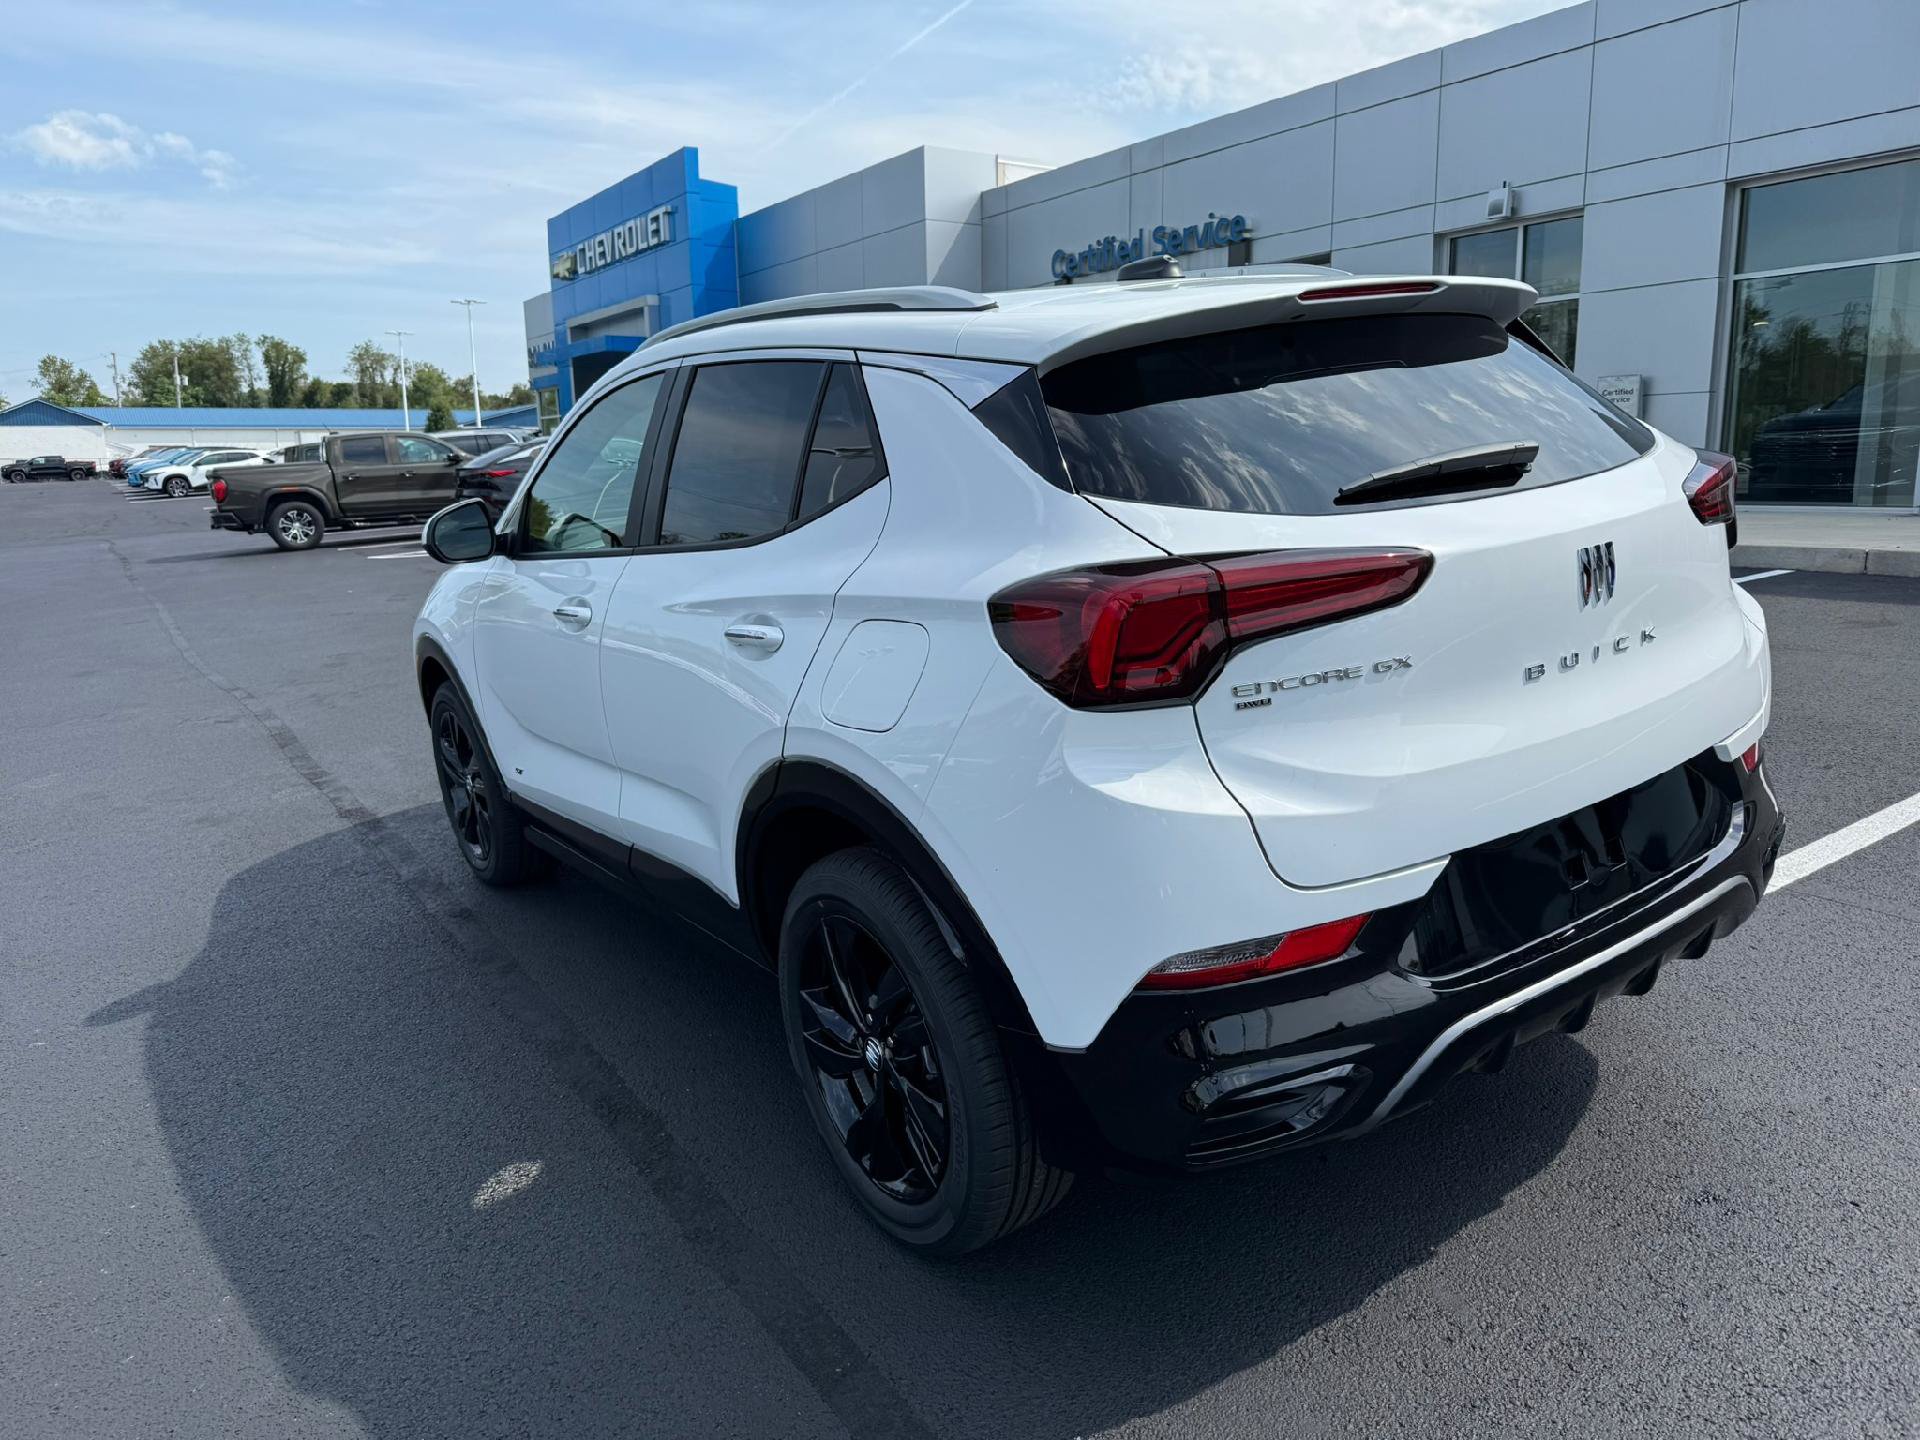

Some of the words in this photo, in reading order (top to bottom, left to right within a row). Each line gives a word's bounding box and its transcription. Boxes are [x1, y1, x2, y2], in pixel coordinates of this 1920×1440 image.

[577, 205, 673, 274] CHEVROLET
[1051, 228, 1144, 279] Certified
[1152, 212, 1246, 256] Service
[1602, 388, 1634, 397] Certified
[1232, 665, 1364, 697] ENCORE
[1372, 655, 1413, 674] GX
[1523, 626, 1657, 684] BUICK
